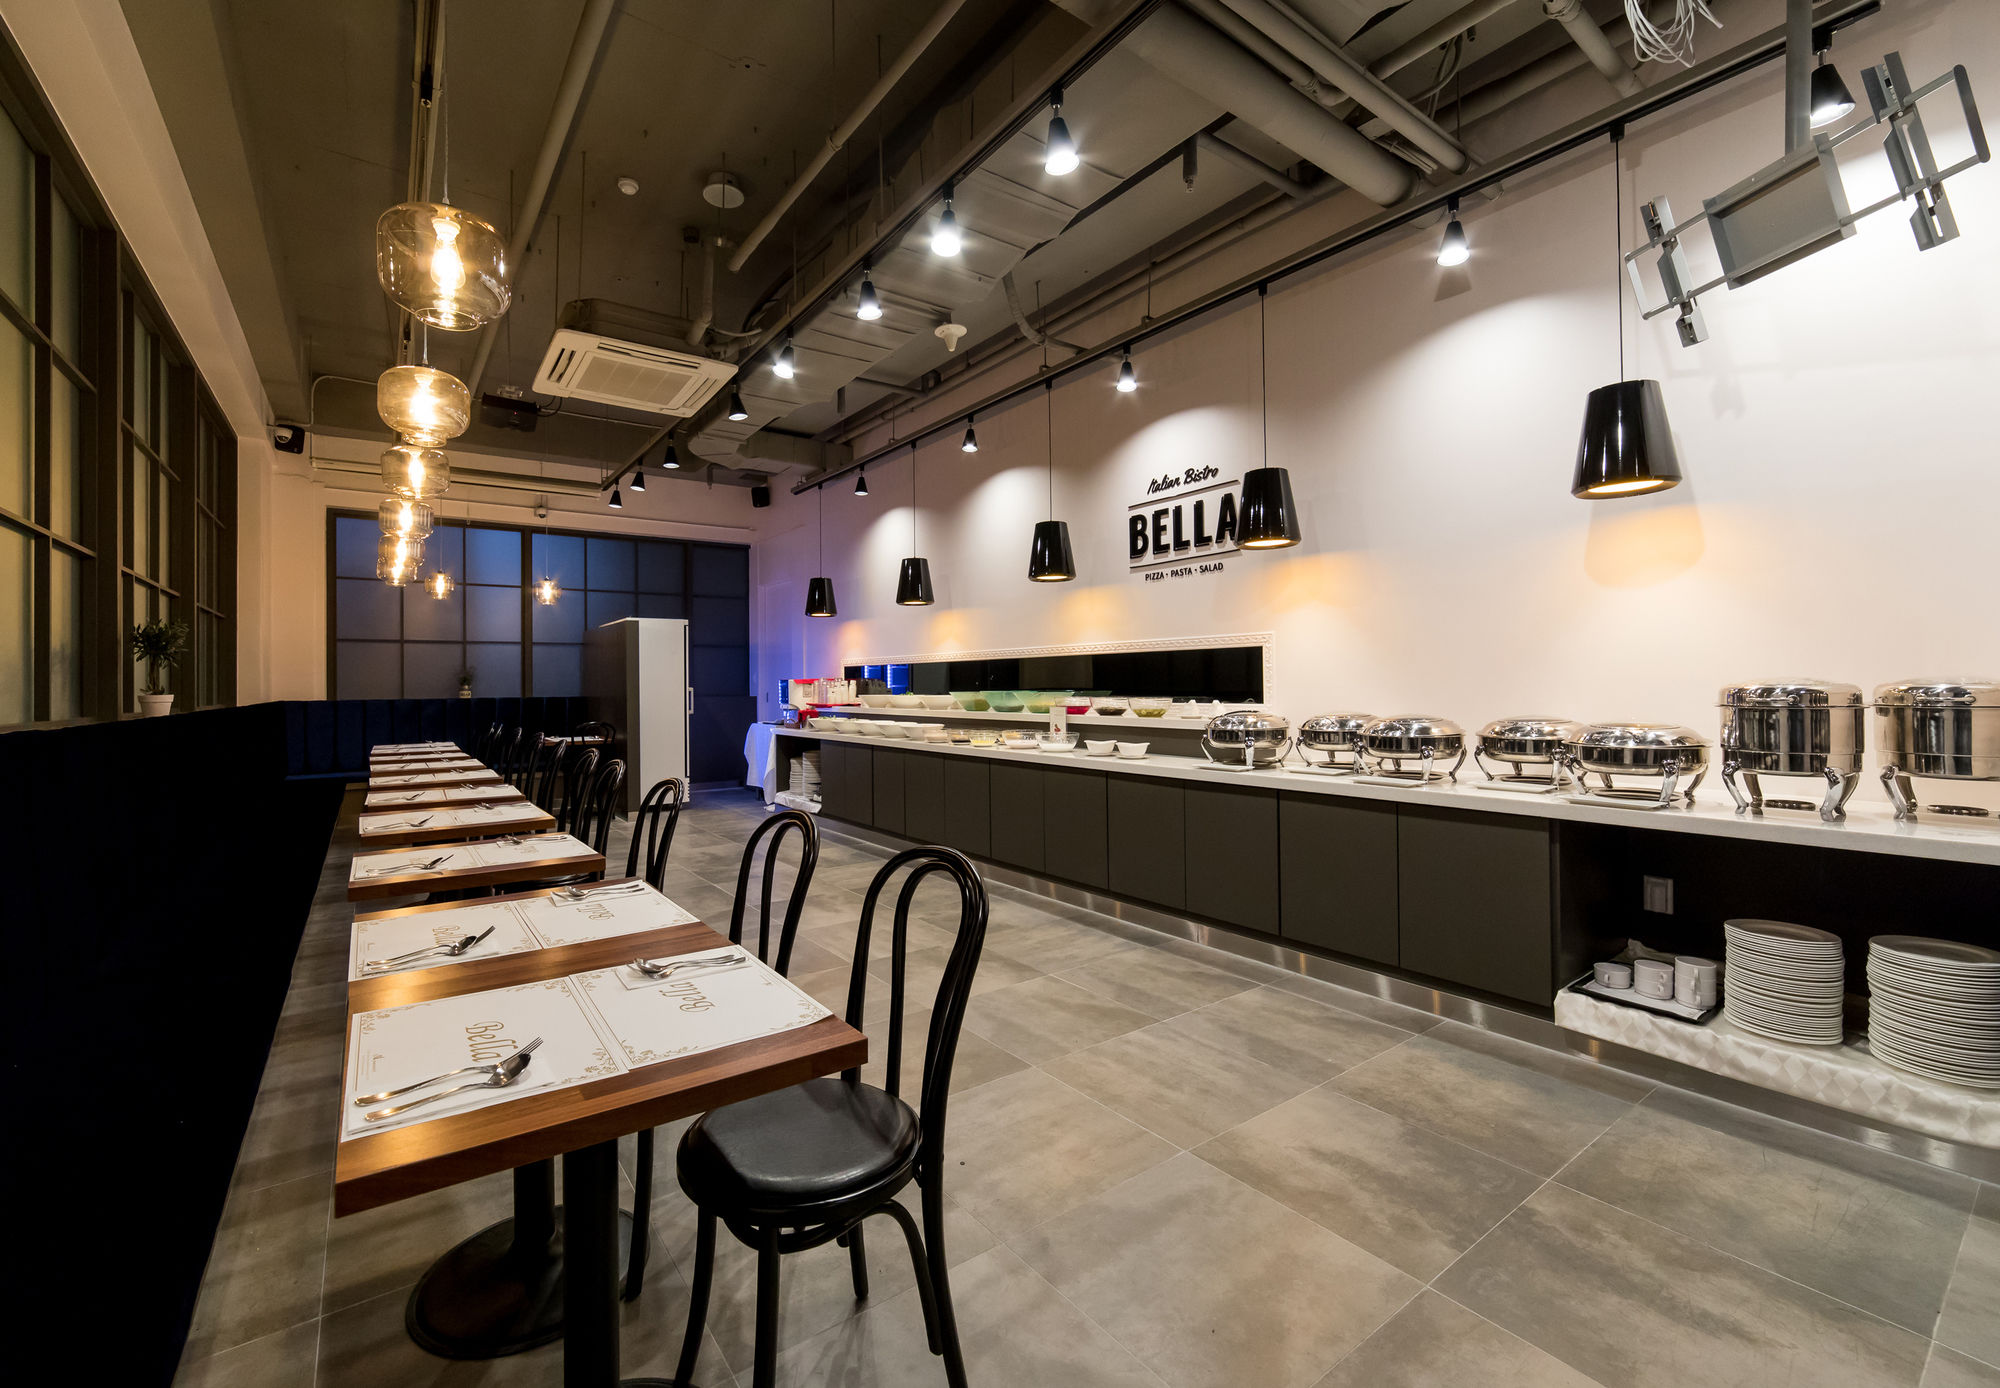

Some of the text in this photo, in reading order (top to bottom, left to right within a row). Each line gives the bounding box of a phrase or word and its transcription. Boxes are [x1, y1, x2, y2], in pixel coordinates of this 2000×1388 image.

[1147, 465, 1219, 494] Italian Bistro
[1129, 493, 1238, 559] BELLA
[1145, 562, 1224, 581] PIZZA PASTA SALAD
[658, 982, 716, 1012] Bella
[465, 1021, 519, 1062] Bella
